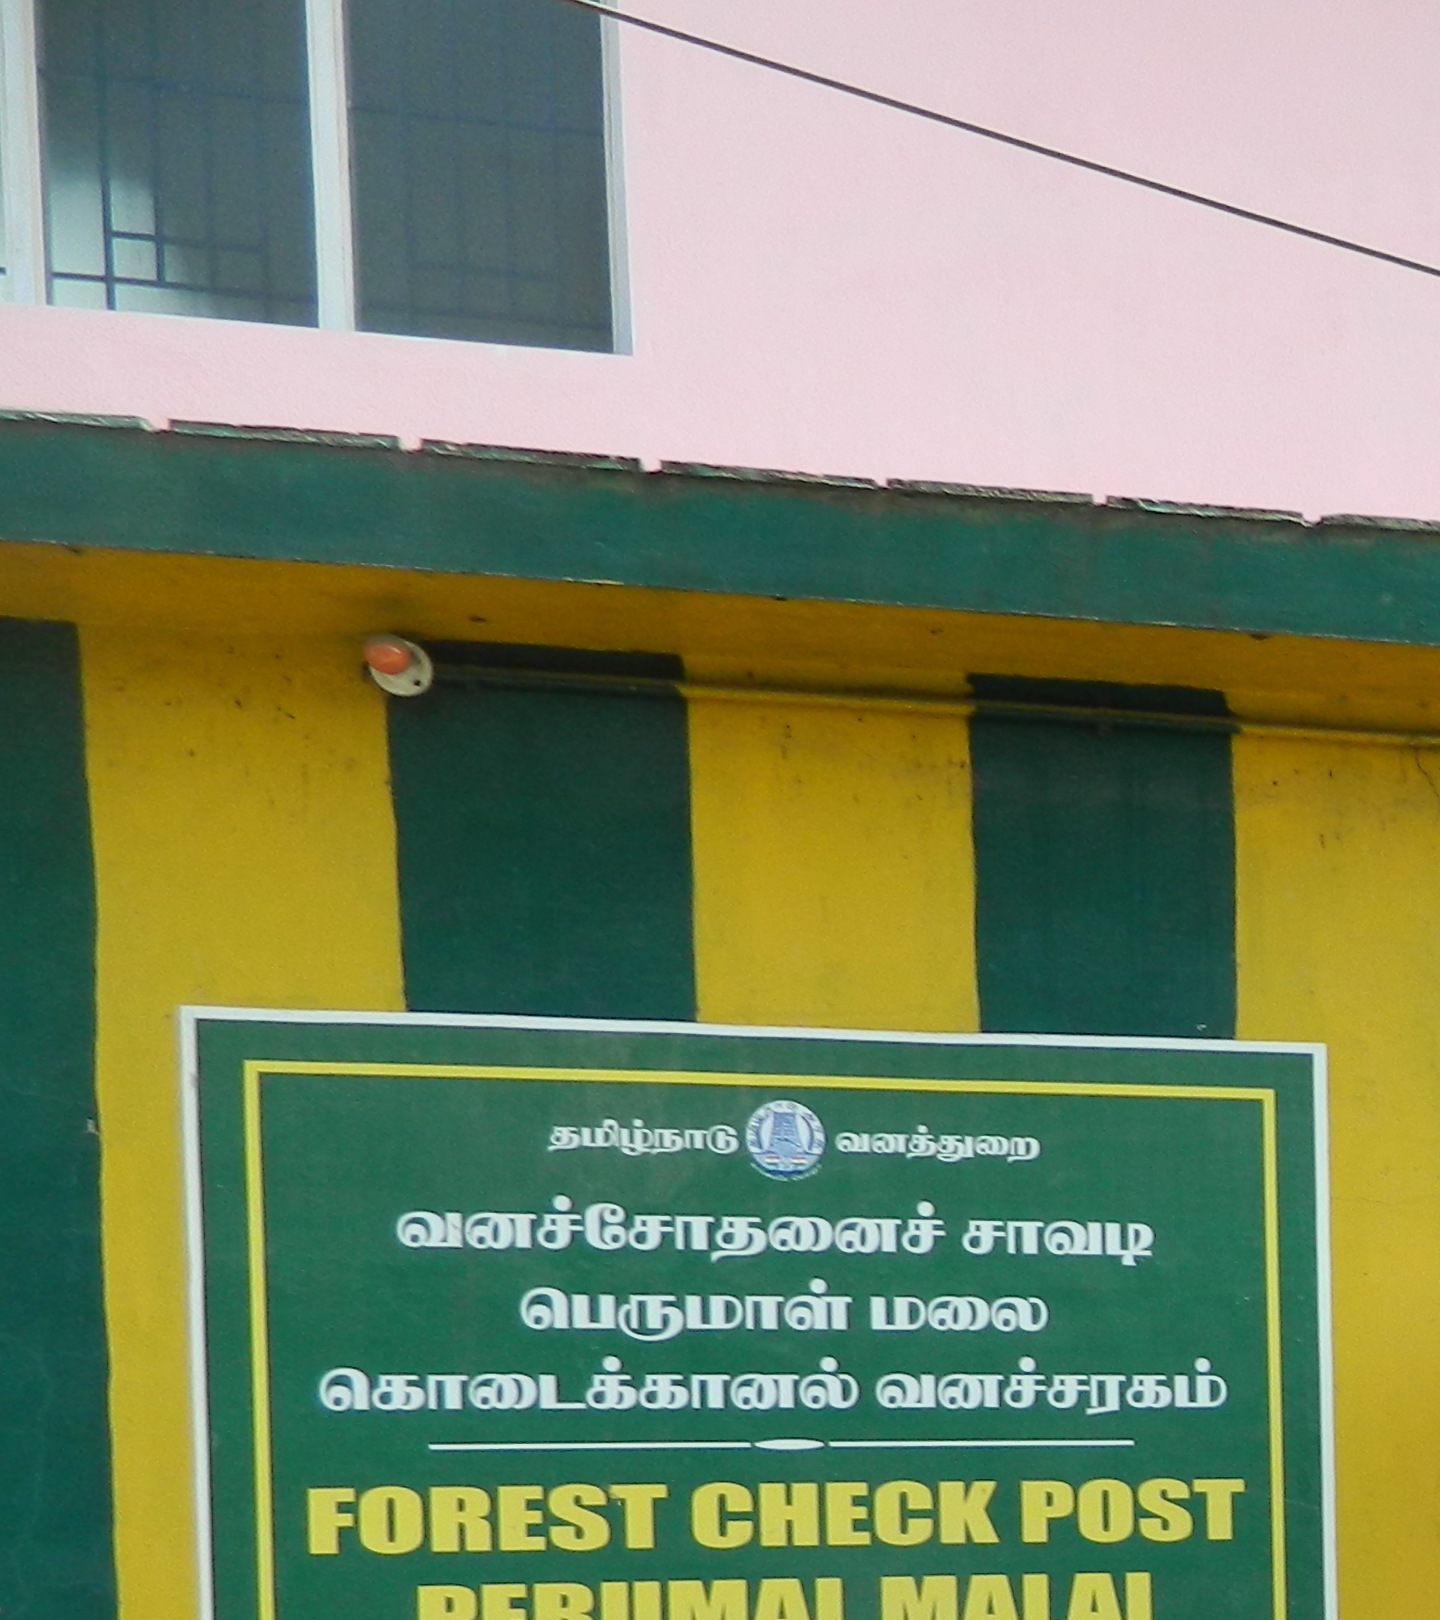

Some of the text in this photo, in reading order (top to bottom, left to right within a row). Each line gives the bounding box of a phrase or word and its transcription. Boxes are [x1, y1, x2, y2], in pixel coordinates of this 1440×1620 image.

[547, 1117, 740, 1157] தமிழ்நாடு
[834, 1123, 1042, 1163] வனத்துறை
[396, 1195, 1155, 1266] வனச்சோதனைச் சாவடி
[520, 1278, 1049, 1343] பெருமாள் மலை
[318, 1356, 1228, 1416] கொடைக்கானல் வனச்சரகம்
[307, 1477, 1246, 1556] FOREST CHECK POST
